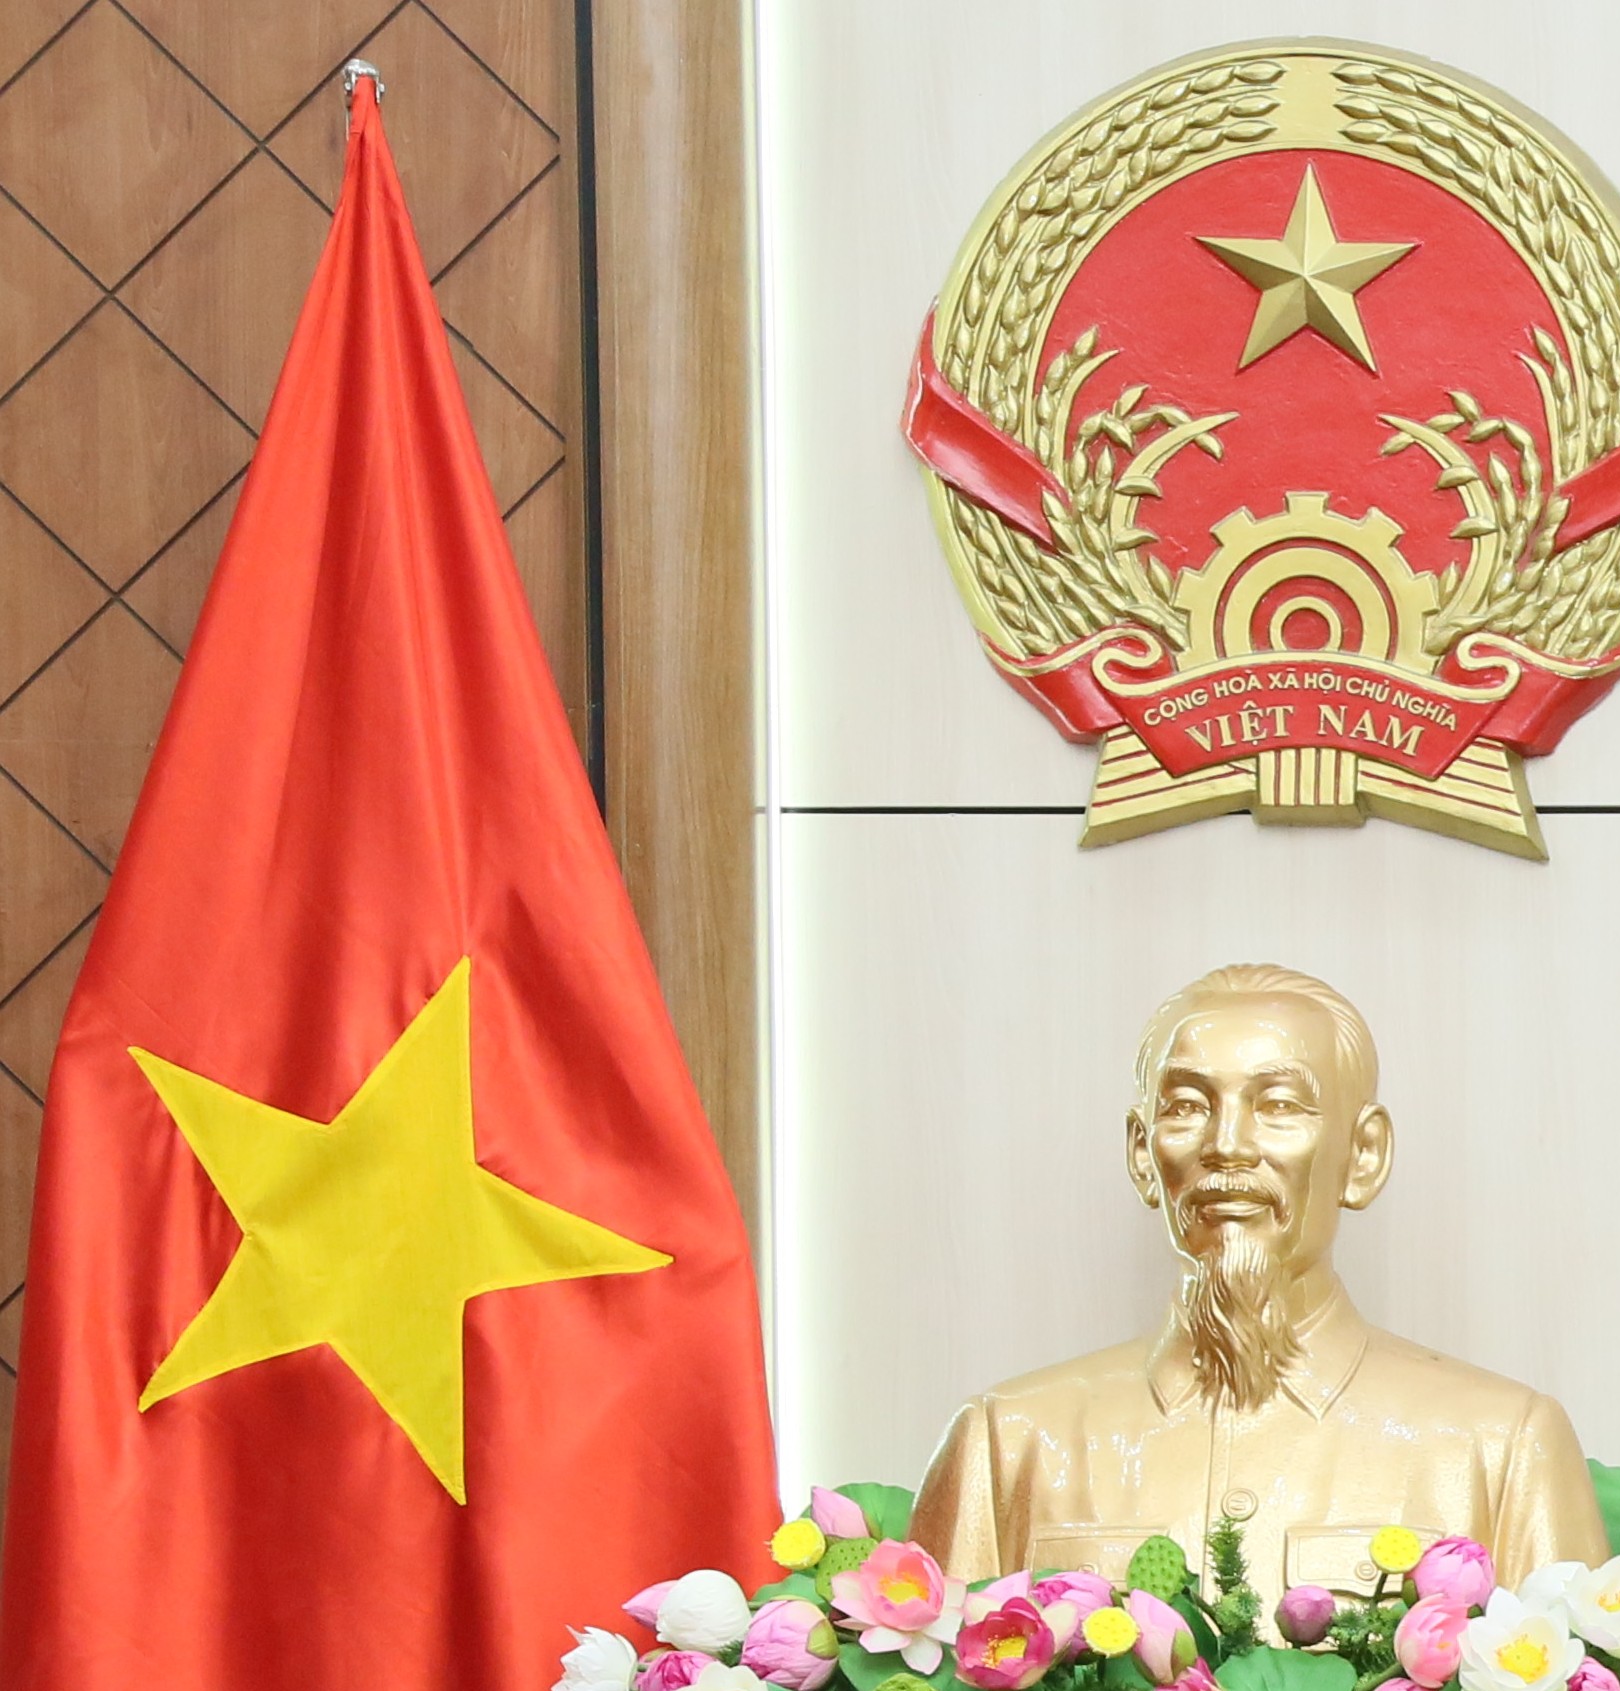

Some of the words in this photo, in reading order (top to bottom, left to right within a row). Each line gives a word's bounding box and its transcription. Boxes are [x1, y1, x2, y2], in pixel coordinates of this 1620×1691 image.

[1144, 688, 1209, 726] CỘNG
[1213, 669, 1263, 698] HOÀ
[1268, 668, 1300, 689] XÃ
[1304, 668, 1342, 694] HỘI
[1345, 677, 1390, 703] CHỦ
[1391, 690, 1457, 731] NGHĨA
[1184, 700, 1294, 753] VIỆT
[1317, 704, 1426, 757] NAM
